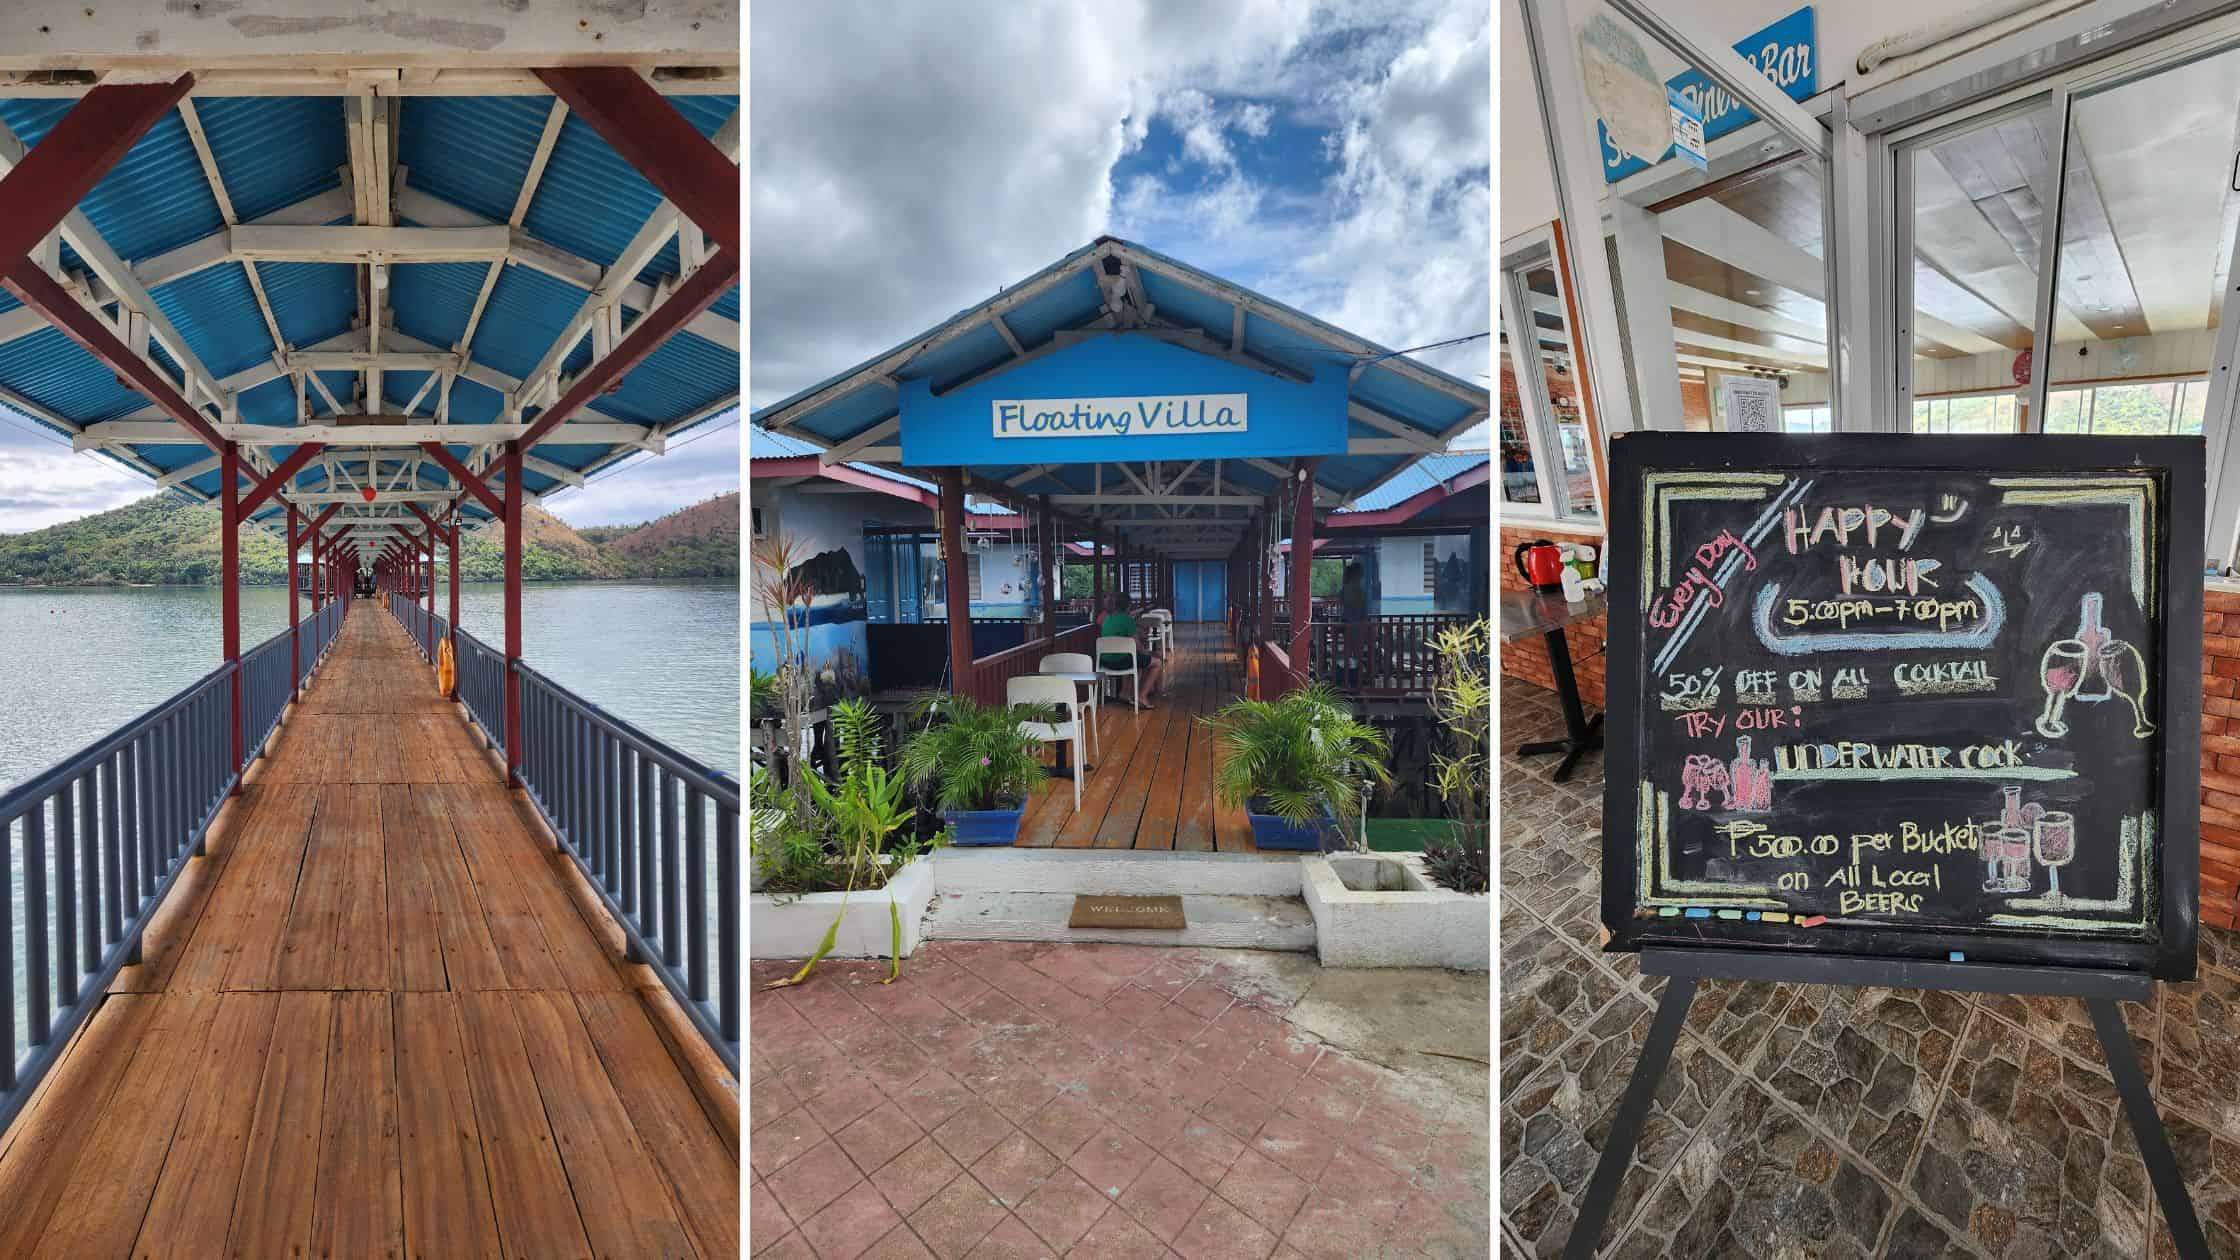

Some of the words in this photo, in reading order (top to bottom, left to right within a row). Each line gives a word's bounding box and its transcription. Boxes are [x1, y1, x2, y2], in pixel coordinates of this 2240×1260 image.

[999, 403, 1132, 434] Floating
[1138, 399, 1241, 429] Villa
[1783, 503, 1926, 555] HAPPY
[1838, 554, 1942, 596] HOUR
[1649, 566, 1724, 628] Every
[1660, 664, 1724, 700] 50%
[1735, 669, 1778, 694] OFF
[1788, 667, 1823, 690] ON
[1893, 659, 2001, 688] COCKTAIL
[1674, 711, 1728, 739] TRY
[1773, 740, 1954, 771] UNDERWATER
[1849, 831, 1894, 866] per
[1899, 816, 1979, 855] Bucket
[1776, 871, 1809, 892] on
[1871, 862, 1941, 893] Local
[1838, 890, 1924, 915] BEERS
